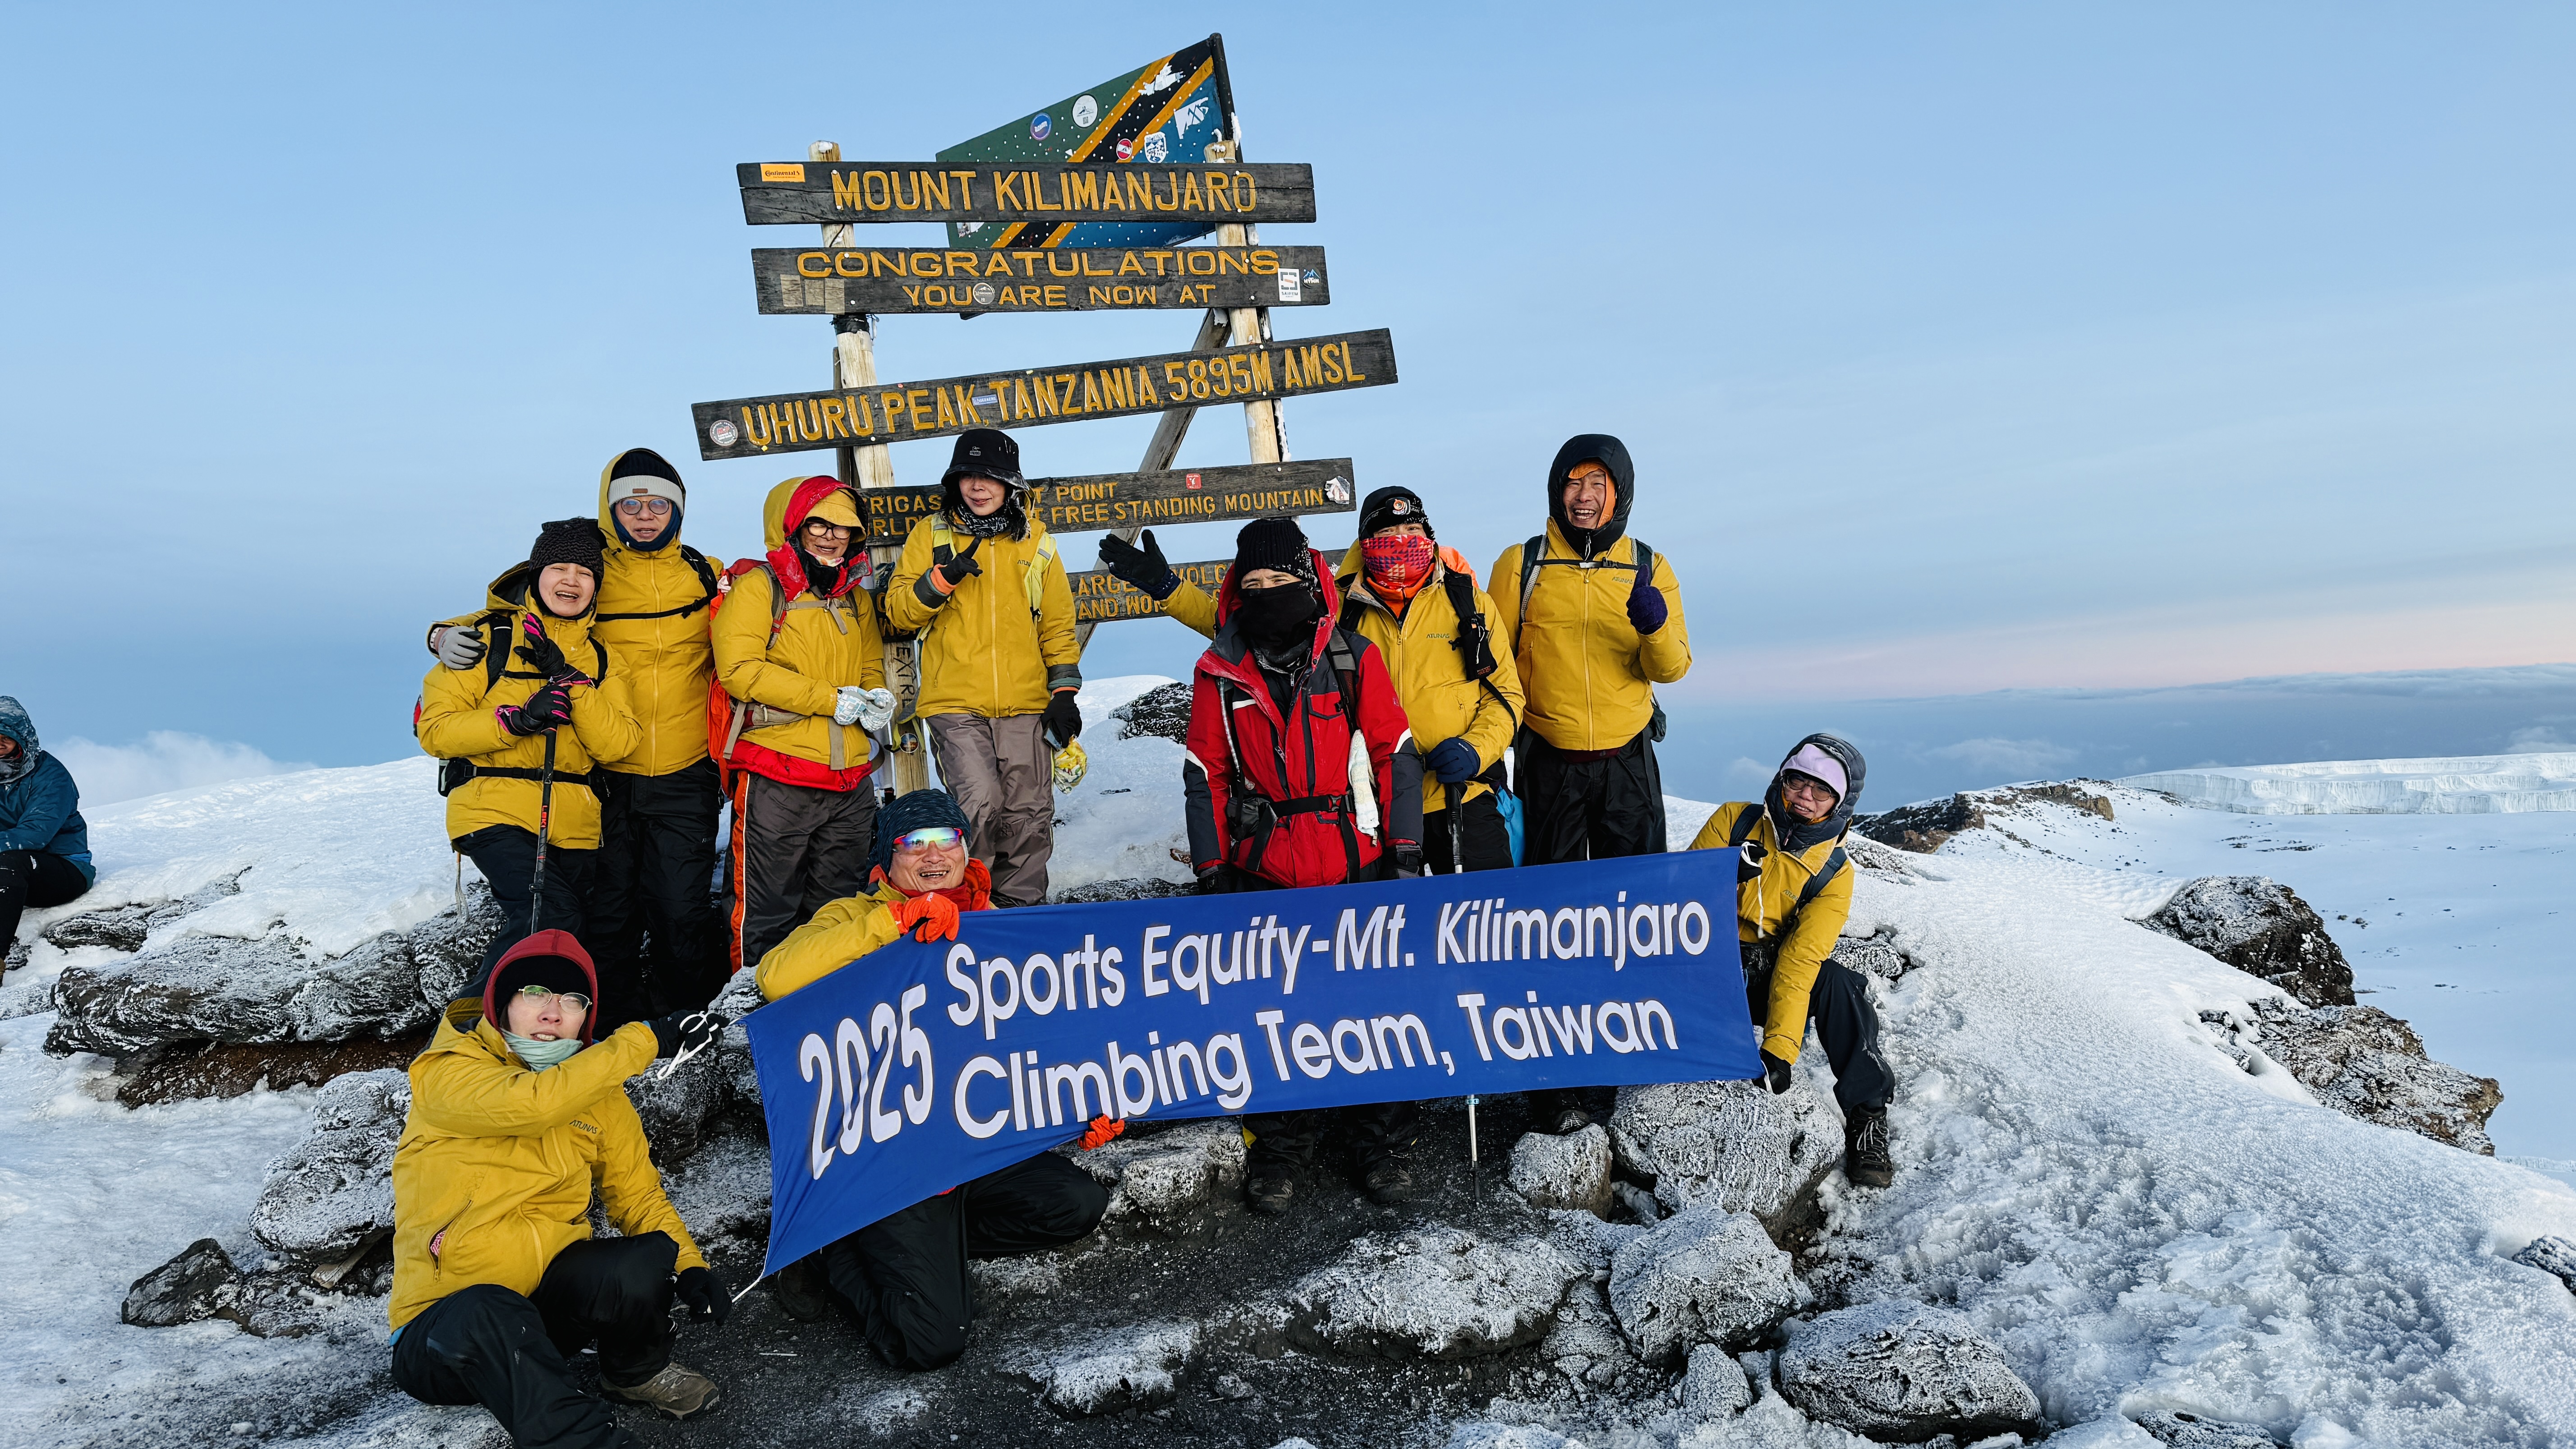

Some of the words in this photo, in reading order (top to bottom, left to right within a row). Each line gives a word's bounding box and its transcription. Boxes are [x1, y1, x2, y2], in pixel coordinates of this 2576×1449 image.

[831, 170, 976, 211] MOUNT
[993, 171, 1256, 212] KILIMANJARO
[797, 251, 1279, 278] CONGRATULATIONS
[902, 285, 972, 306] YOU
[998, 285, 1067, 306] ARE
[1089, 285, 1156, 305] NOW
[1180, 284, 1216, 304] AT
[741, 394, 874, 446] UHURU
[1164, 350, 1274, 401] 5895M
[1284, 340, 1366, 389] AMSL
[865, 494, 941, 515] RICAS
[1056, 482, 1118, 502] POINT
[1051, 503, 1110, 524] FREE
[1114, 496, 1216, 520] STANDING
[1224, 487, 1324, 512] MOUNTAIN
[1072, 574, 1138, 596] ARGE
[1078, 597, 1118, 620] AND
[946, 934, 1126, 1040] Sports
[1143, 904, 1414, 1005] Equity-Mt.
[1437, 891, 1710, 972] Kilimanjaro
[800, 983, 934, 1180] 2025
[955, 1030, 1252, 1139] Climbing
[1255, 1009, 1455, 1081] Team,
[1457, 990, 1679, 1061] Taiwan
[569, 1120, 598, 1133] ATUNAS
